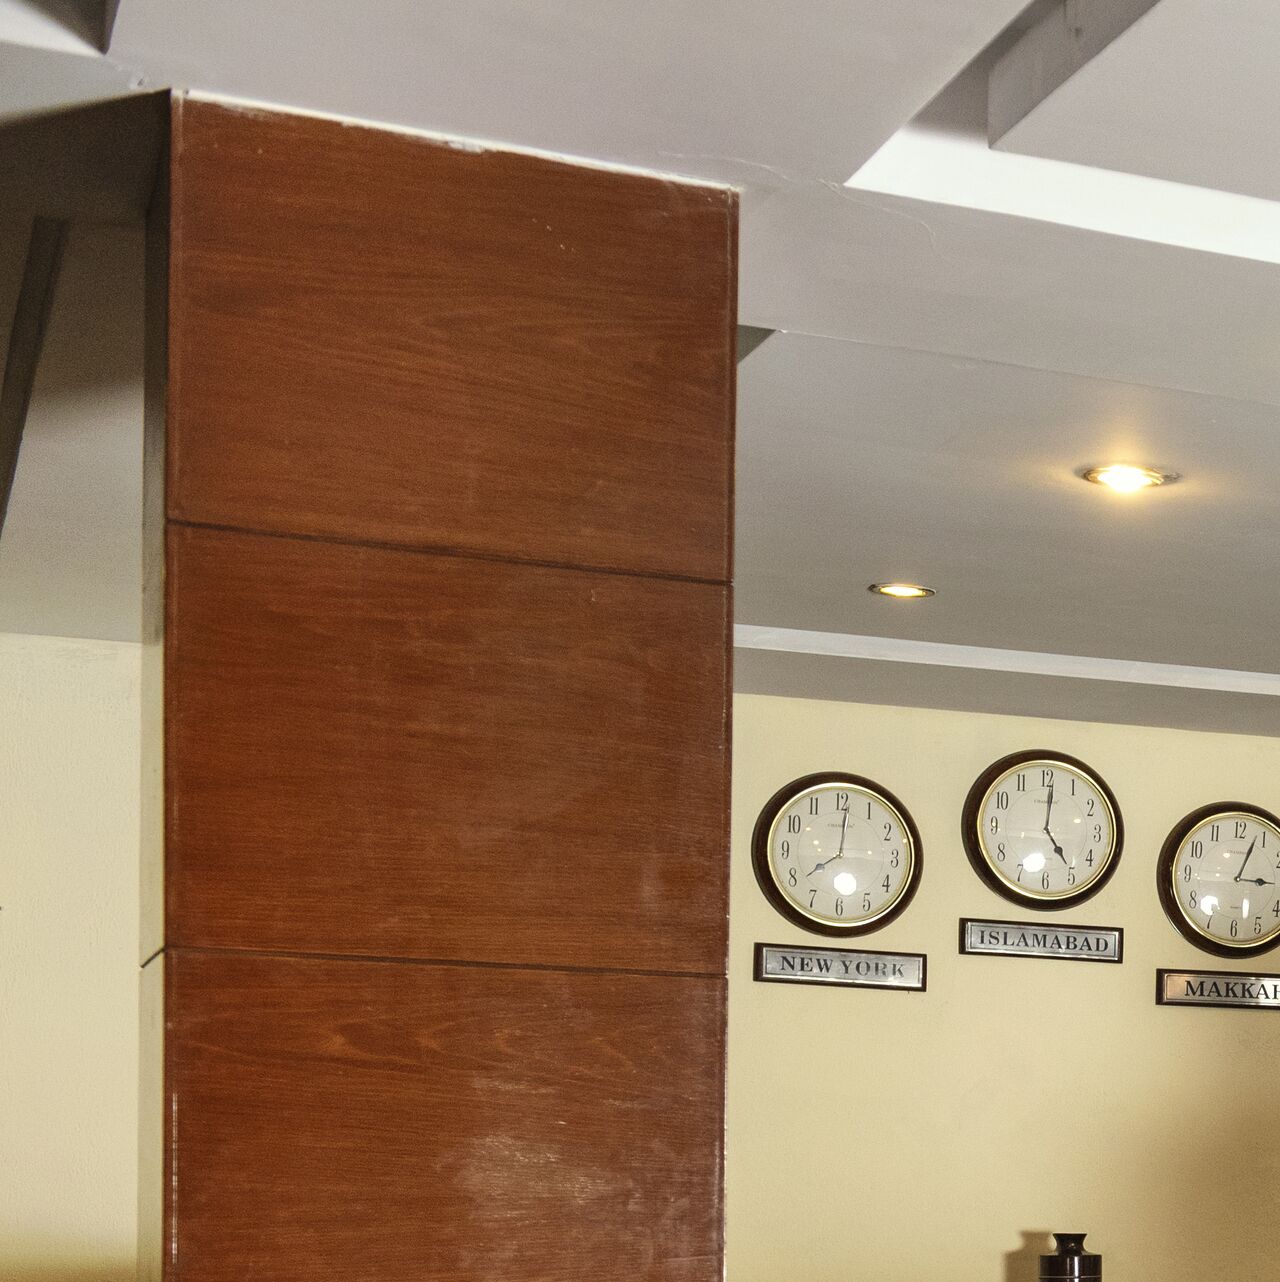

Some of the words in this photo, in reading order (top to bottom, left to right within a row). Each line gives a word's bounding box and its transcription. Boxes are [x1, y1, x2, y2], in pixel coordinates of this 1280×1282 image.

[1017, 774, 1025, 792] 11
[1041, 769, 1053, 787] 12
[810, 797, 819, 815] 11
[836, 793, 849, 811] 12
[996, 791, 1009, 810] 10
[1087, 799, 1094, 816] 2
[787, 815, 801, 833] 10
[884, 823, 891, 841] 2
[990, 816, 998, 835] 9
[1211, 824, 1220, 842] 11
[1234, 821, 1247, 839] 12
[1094, 824, 1101, 843] 3
[781, 840, 789, 859] 9
[891, 849, 899, 868] 3
[997, 843, 1005, 862] 8
[1085, 849, 1094, 867] 4
[1190, 841, 1203, 859] 10
[789, 867, 797, 887] 8
[1017, 864, 1024, 882] 7
[1041, 872, 1049, 890] 6
[1068, 866, 1075, 885] 5
[1184, 864, 1192, 882] 9
[882, 874, 891, 893] 4
[809, 889, 817, 908] 7
[835, 898, 843, 916] 6
[863, 893, 871, 911] 5
[1189, 890, 1197, 909] 8
[1272, 900, 1280, 917] 4
[1230, 920, 1238, 937] 6
[1254, 916, 1262, 934] 5
[979, 930, 1109, 952] ISLAMABAD
[780, 956, 833, 974] NEW
[840, 960, 905, 978] YORK
